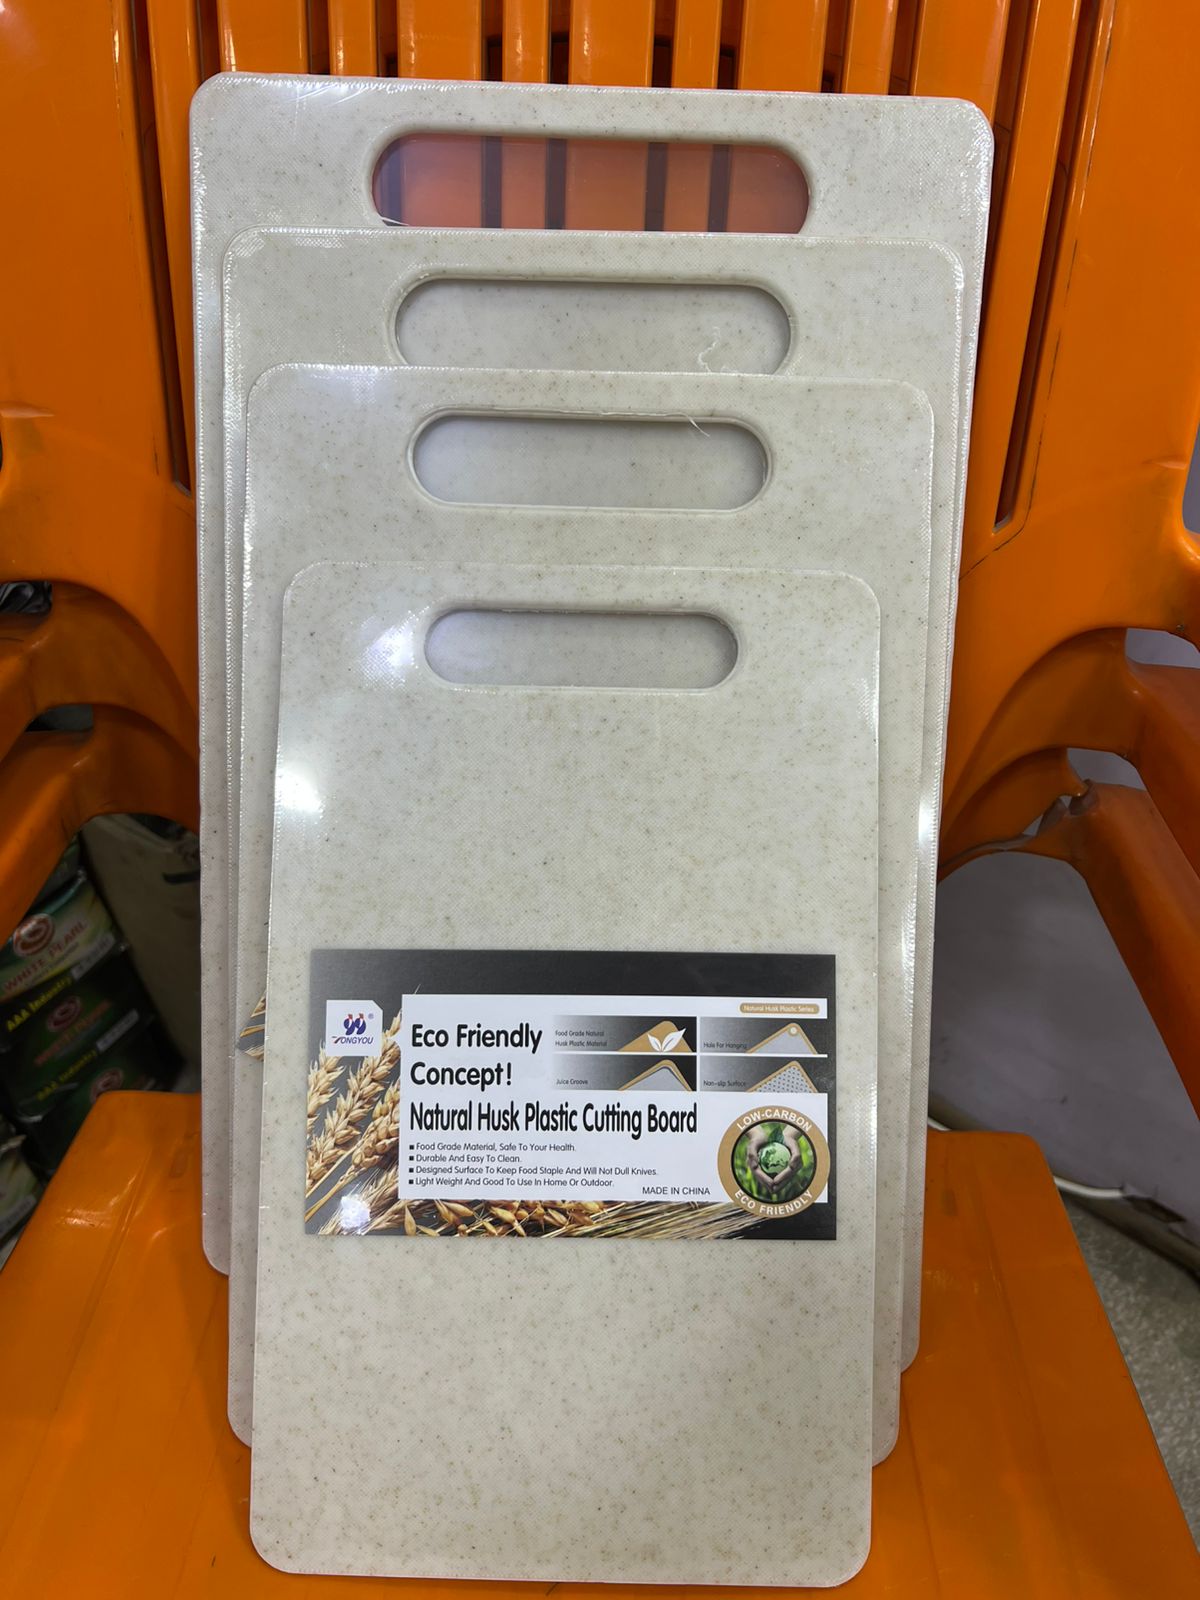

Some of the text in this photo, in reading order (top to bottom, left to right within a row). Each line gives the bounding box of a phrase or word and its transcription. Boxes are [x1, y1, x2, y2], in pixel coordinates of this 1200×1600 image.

[743, 1004, 815, 1014] Natural Husk Plastic Series
[411, 1022, 543, 1054] Eco Friendly
[567, 1030, 585, 1038] Grade
[331, 1035, 374, 1045] TONGYOU
[569, 1040, 589, 1048] Plastic
[590, 1040, 608, 1048] Material
[716, 1042, 725, 1050] For
[725, 1042, 748, 1051] Hanging
[410, 1061, 512, 1092] Concept!
[570, 1078, 589, 1086] Groove
[703, 1080, 747, 1088] Non-slip Surface
[410, 1100, 698, 1140] Natural Husk Plastic Cutting Board
[736, 1108, 813, 1132] LOW-CARBON
[416, 1142, 576, 1153] Food Grade Material, Safe To Your Health.
[416, 1154, 521, 1164] Durable And Easy To Clean.
[416, 1165, 658, 1177] Designed Surface To Keep Food Staple And Will Not Dull Knives.
[416, 1177, 615, 1188] Light Weight And Good To Use In Home Or Outdoor.
[642, 1187, 711, 1196] MADE IN CHINA
[734, 1190, 813, 1216] ECO FRIENDLY
